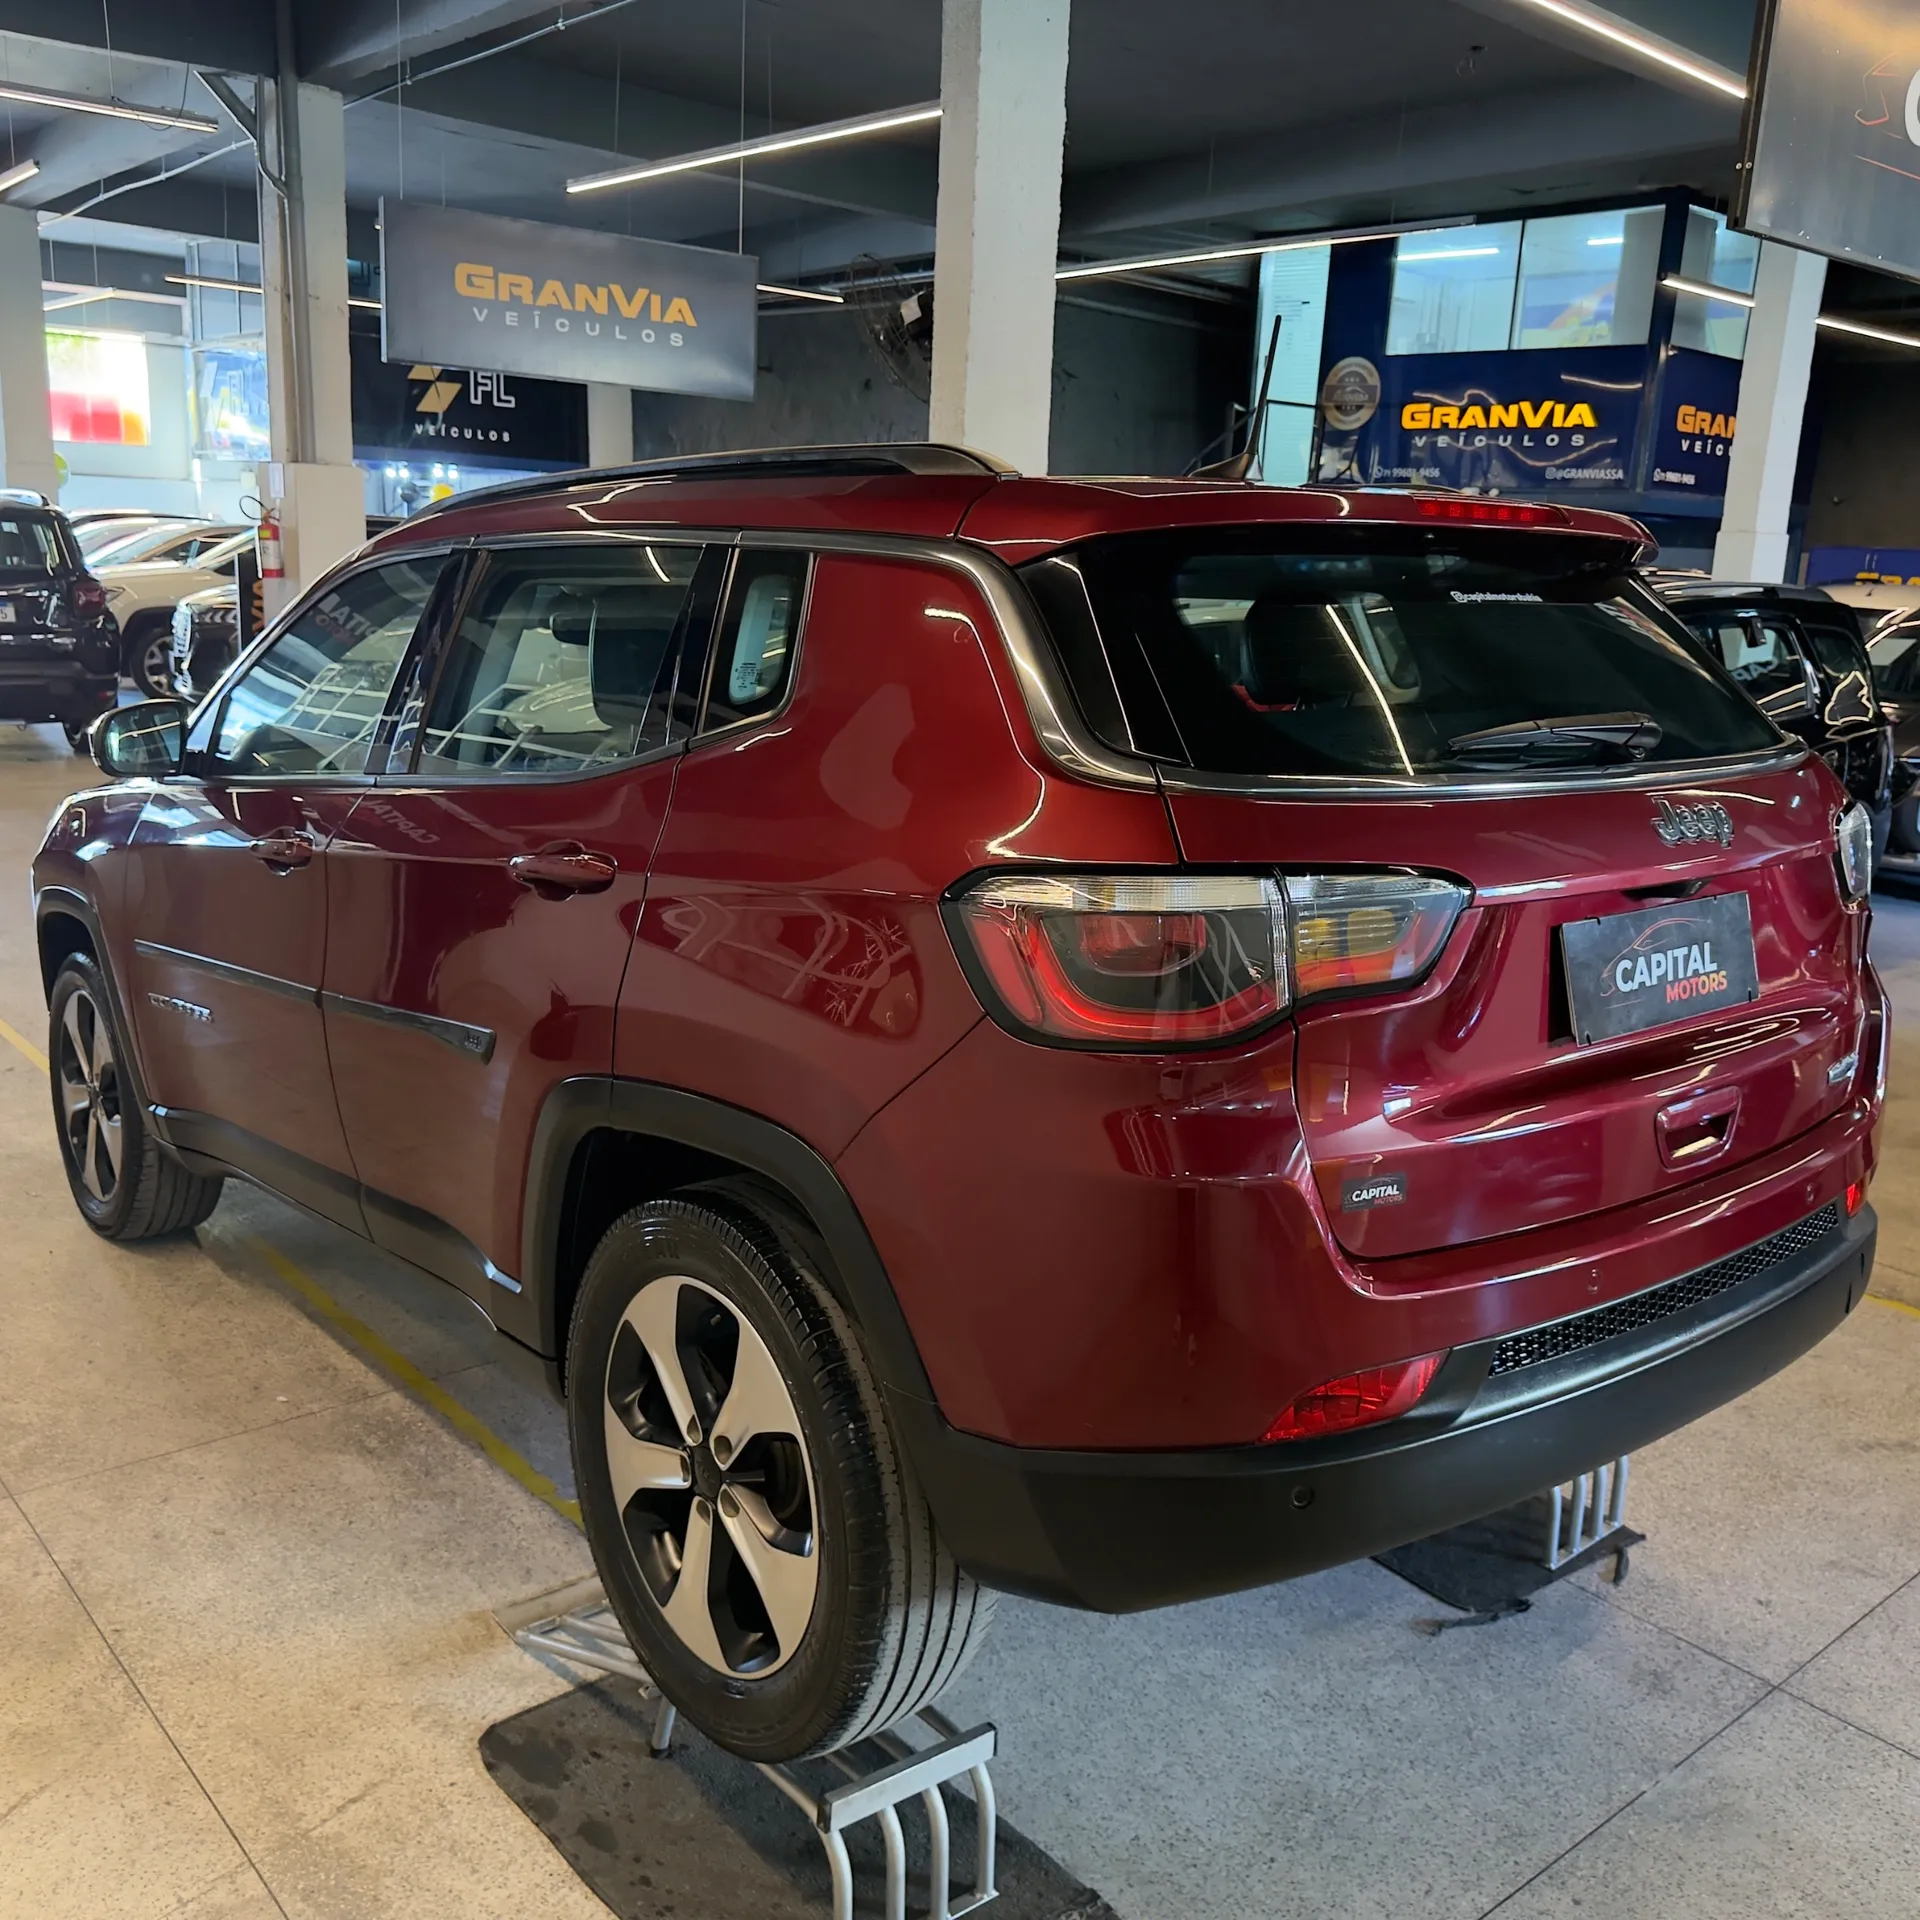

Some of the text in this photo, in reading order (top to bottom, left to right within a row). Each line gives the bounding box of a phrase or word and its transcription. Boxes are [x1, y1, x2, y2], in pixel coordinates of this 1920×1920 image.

[472, 306, 684, 347] VEÍCULOS
[414, 422, 511, 442] VEÍCULOS
[1414, 431, 1585, 448] VEÍCULOS
[1651, 795, 1734, 850] Jeep
[1615, 942, 1718, 993] CAPITAL
[1666, 970, 1728, 1004] MOTORS
[1352, 1184, 1400, 1202] CAPITAL
[1374, 1194, 1403, 1204] MOTORS
